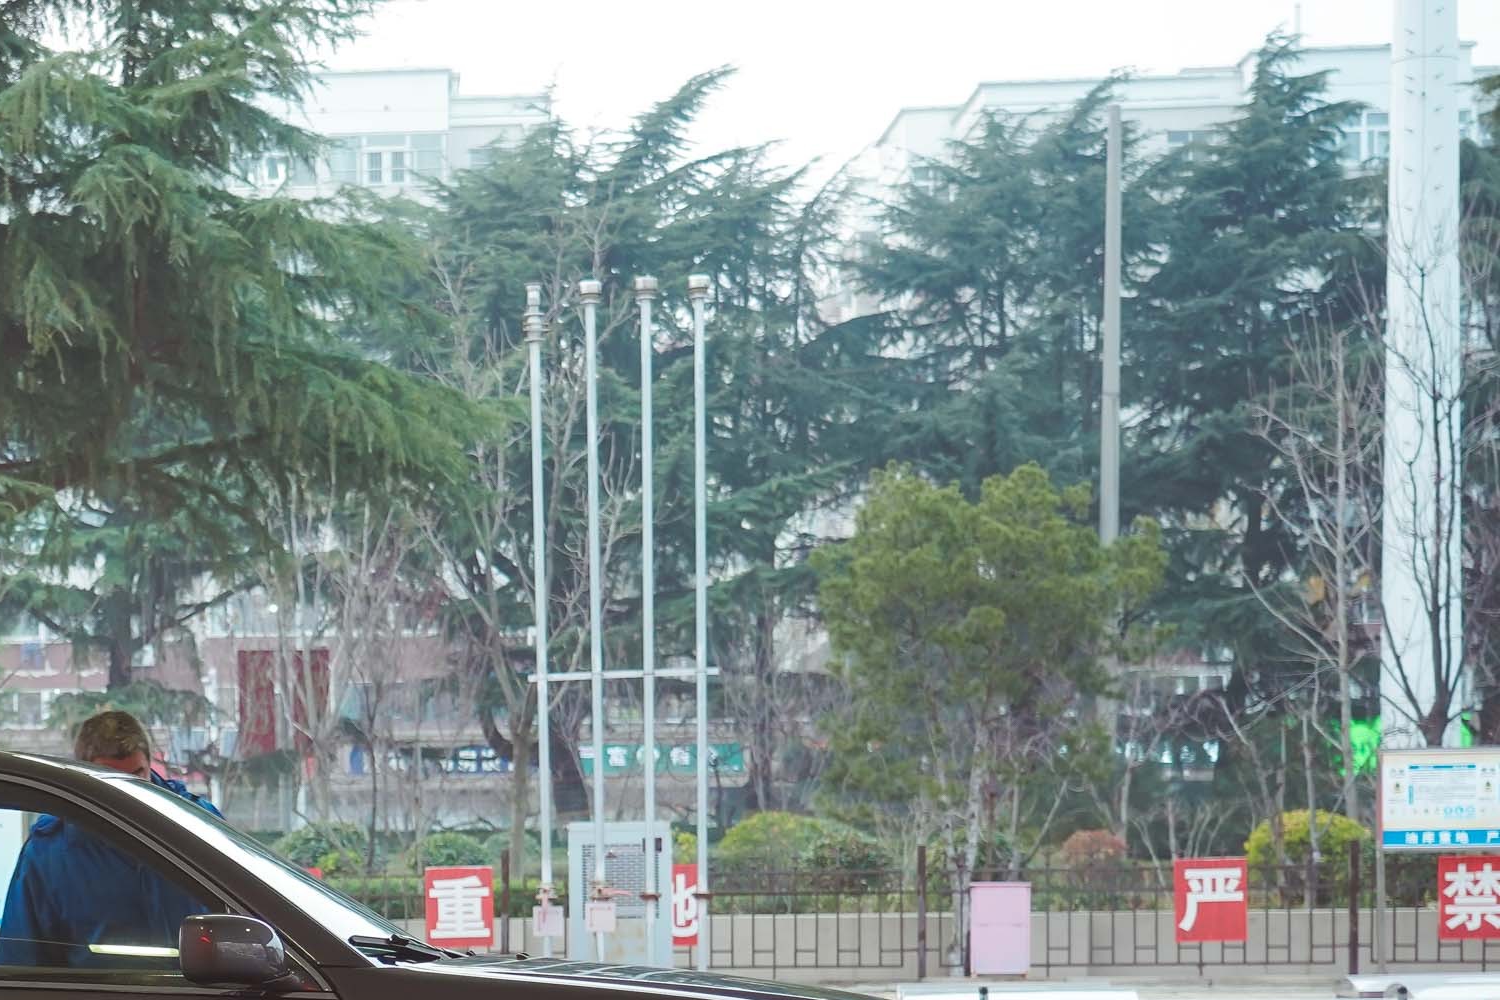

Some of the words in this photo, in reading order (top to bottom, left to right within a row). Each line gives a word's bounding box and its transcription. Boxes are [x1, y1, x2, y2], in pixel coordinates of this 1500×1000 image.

[428, 875, 491, 940] 重
[1178, 868, 1244, 932] 严
[1443, 863, 1500, 932] 禁
